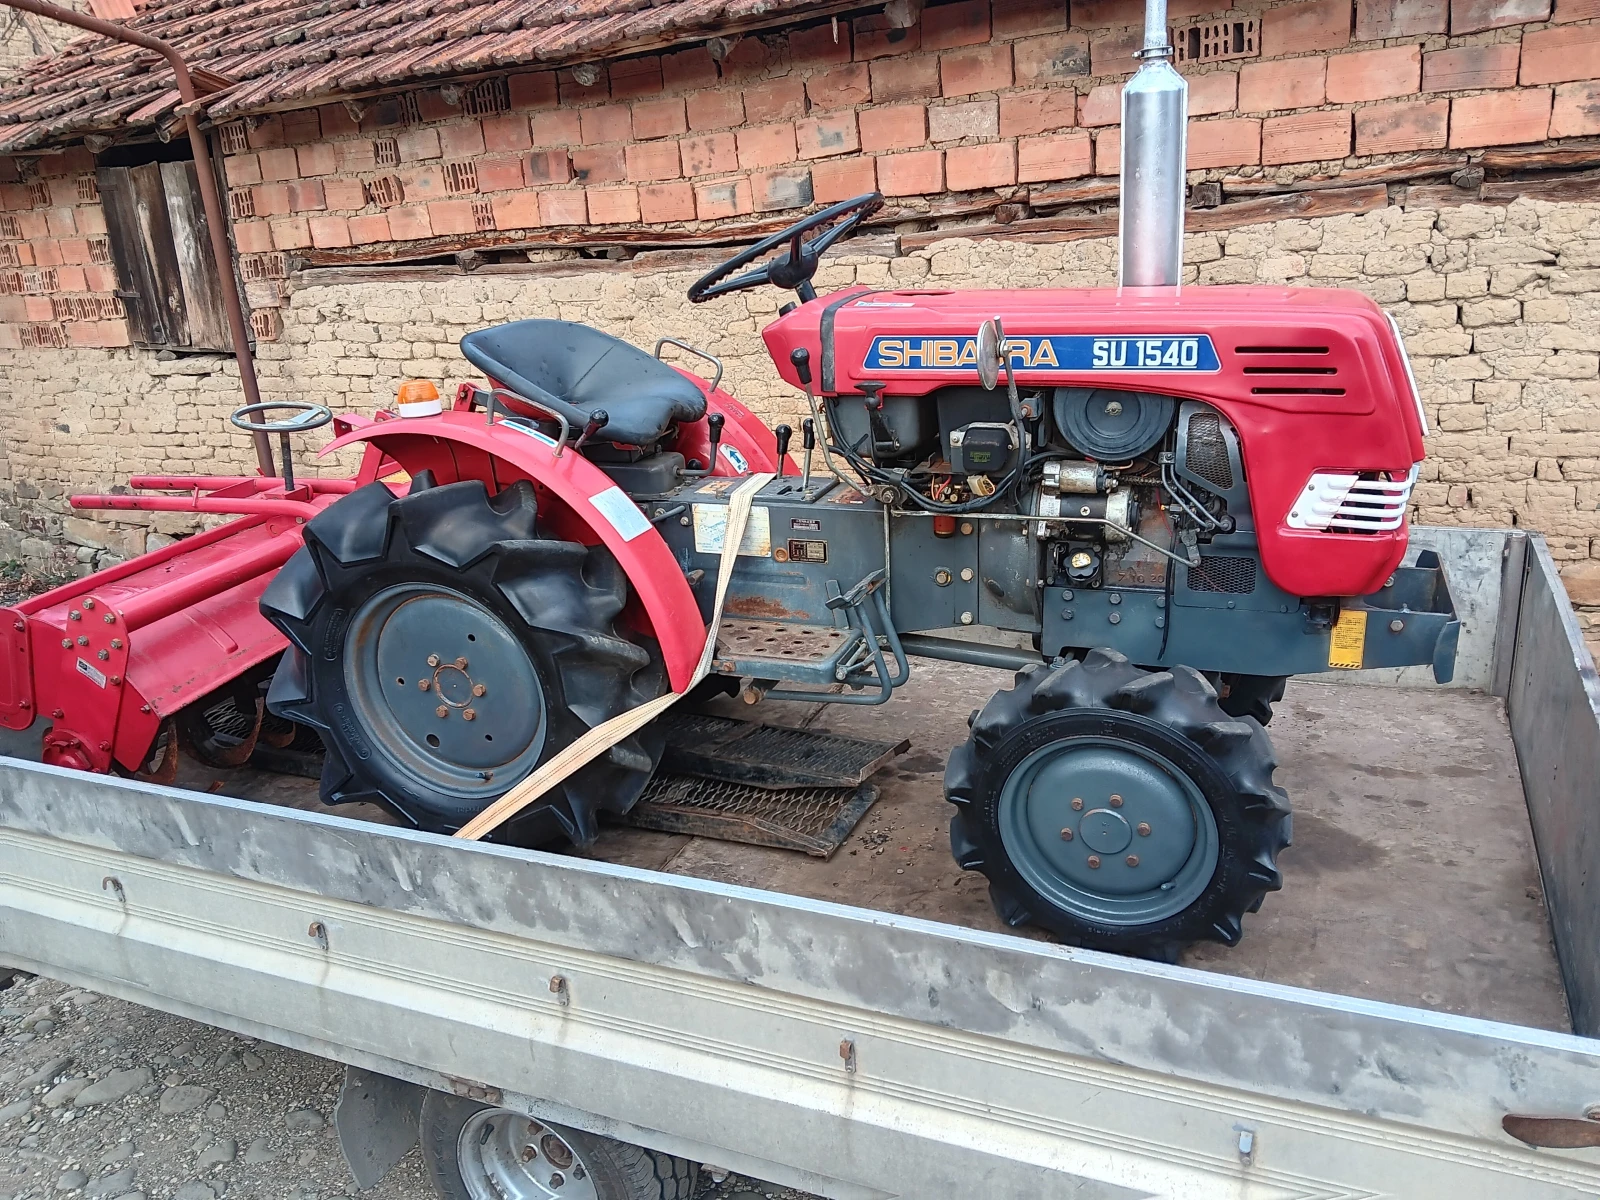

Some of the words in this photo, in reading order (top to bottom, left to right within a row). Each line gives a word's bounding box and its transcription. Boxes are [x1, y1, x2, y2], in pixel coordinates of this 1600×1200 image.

[878, 340, 1060, 367] SHIBARA
[1092, 340, 1128, 367] SU
[1135, 340, 1199, 367] 1540
